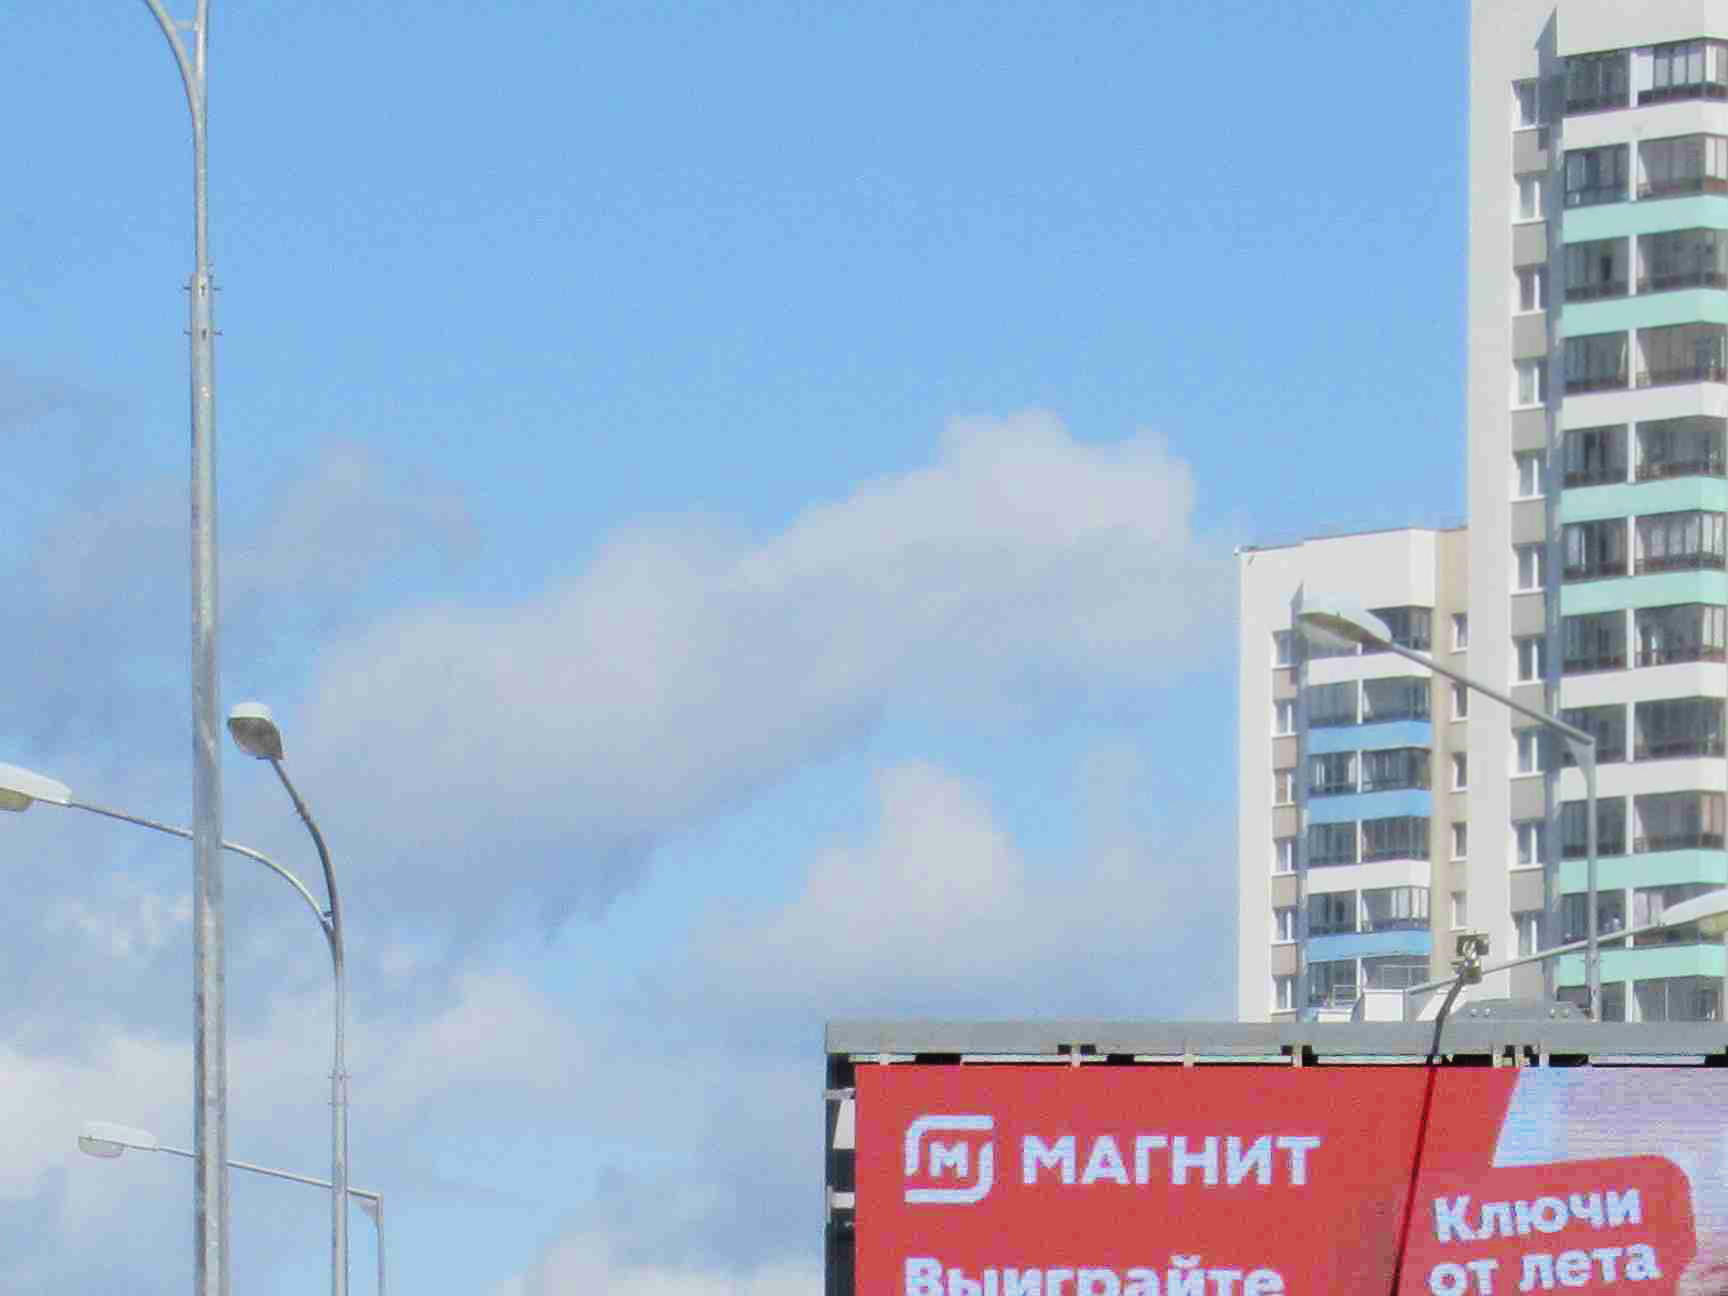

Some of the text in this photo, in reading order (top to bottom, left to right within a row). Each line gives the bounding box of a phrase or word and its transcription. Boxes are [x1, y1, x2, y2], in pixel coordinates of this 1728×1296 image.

[1022, 1134, 1323, 1186] МАГНИТ
[1432, 1187, 1642, 1243] Ключи
[1518, 1242, 1664, 1292] лета
